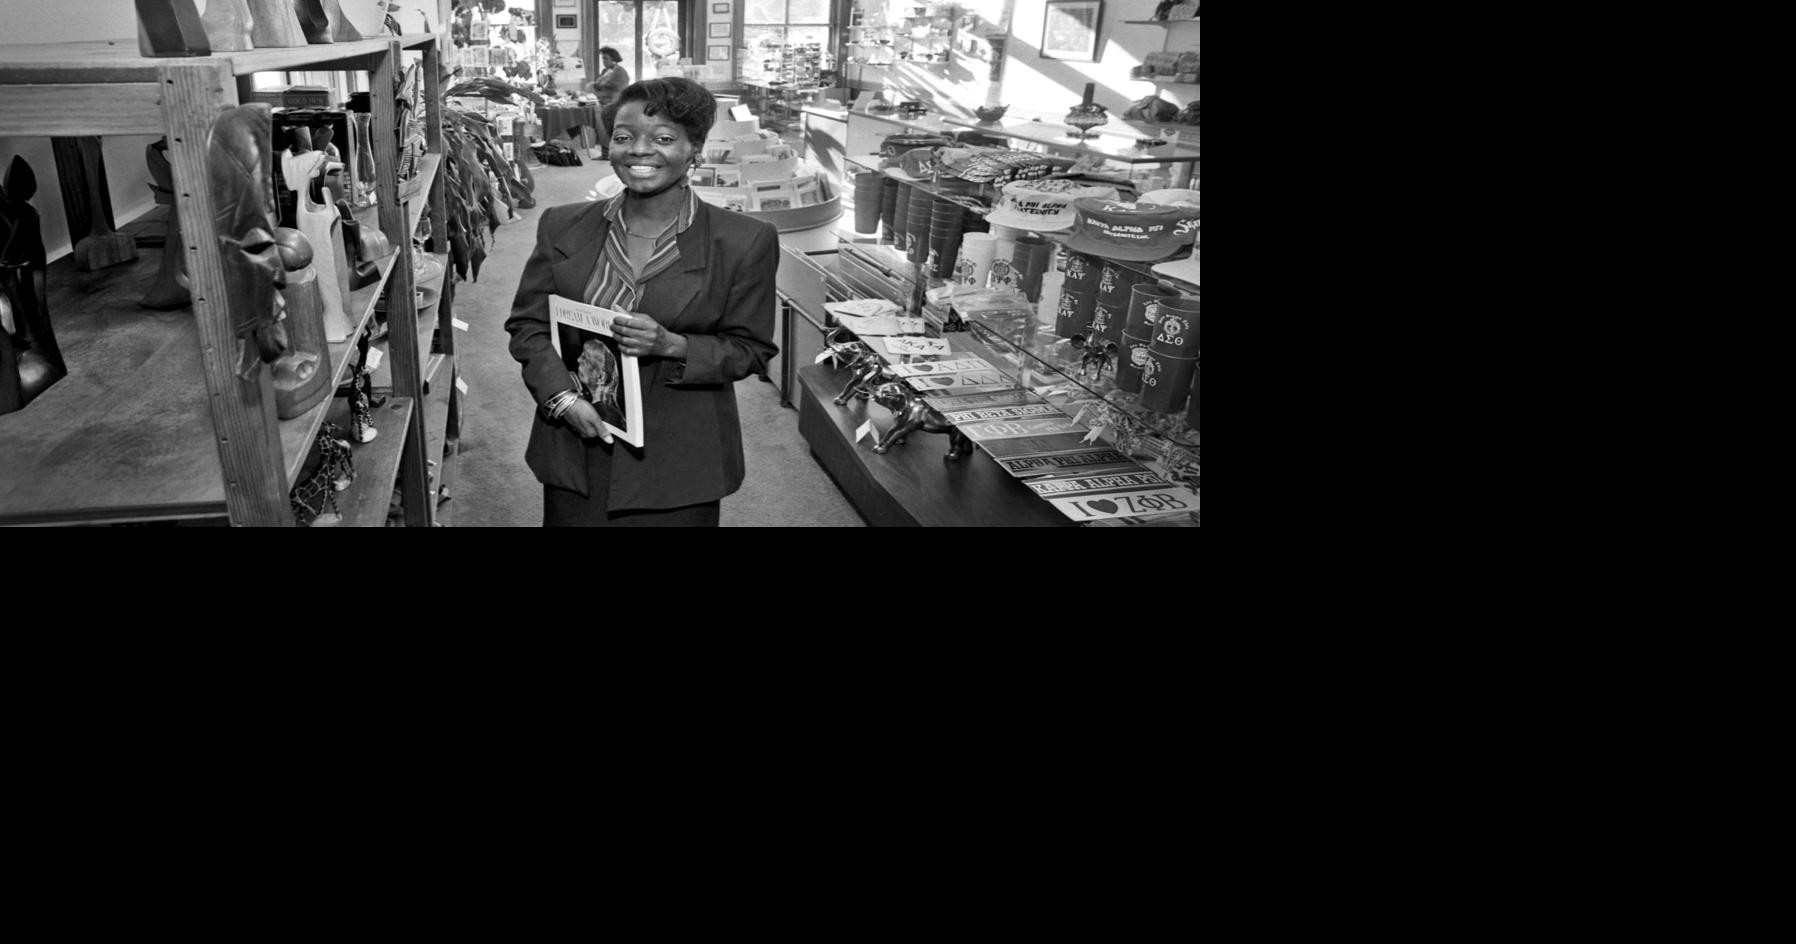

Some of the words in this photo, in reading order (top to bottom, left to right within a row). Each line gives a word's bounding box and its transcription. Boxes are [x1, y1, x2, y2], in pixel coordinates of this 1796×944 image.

[1157, 333, 1184, 346] ΔΣΘ
[1007, 456, 1054, 471] ALPHA
[1055, 454, 1079, 467] PHI
[1031, 479, 1083, 494] KAPPA
[1085, 475, 1134, 489] ALPHA
[1134, 471, 1163, 485] PSI
[1068, 501, 1096, 517] I
